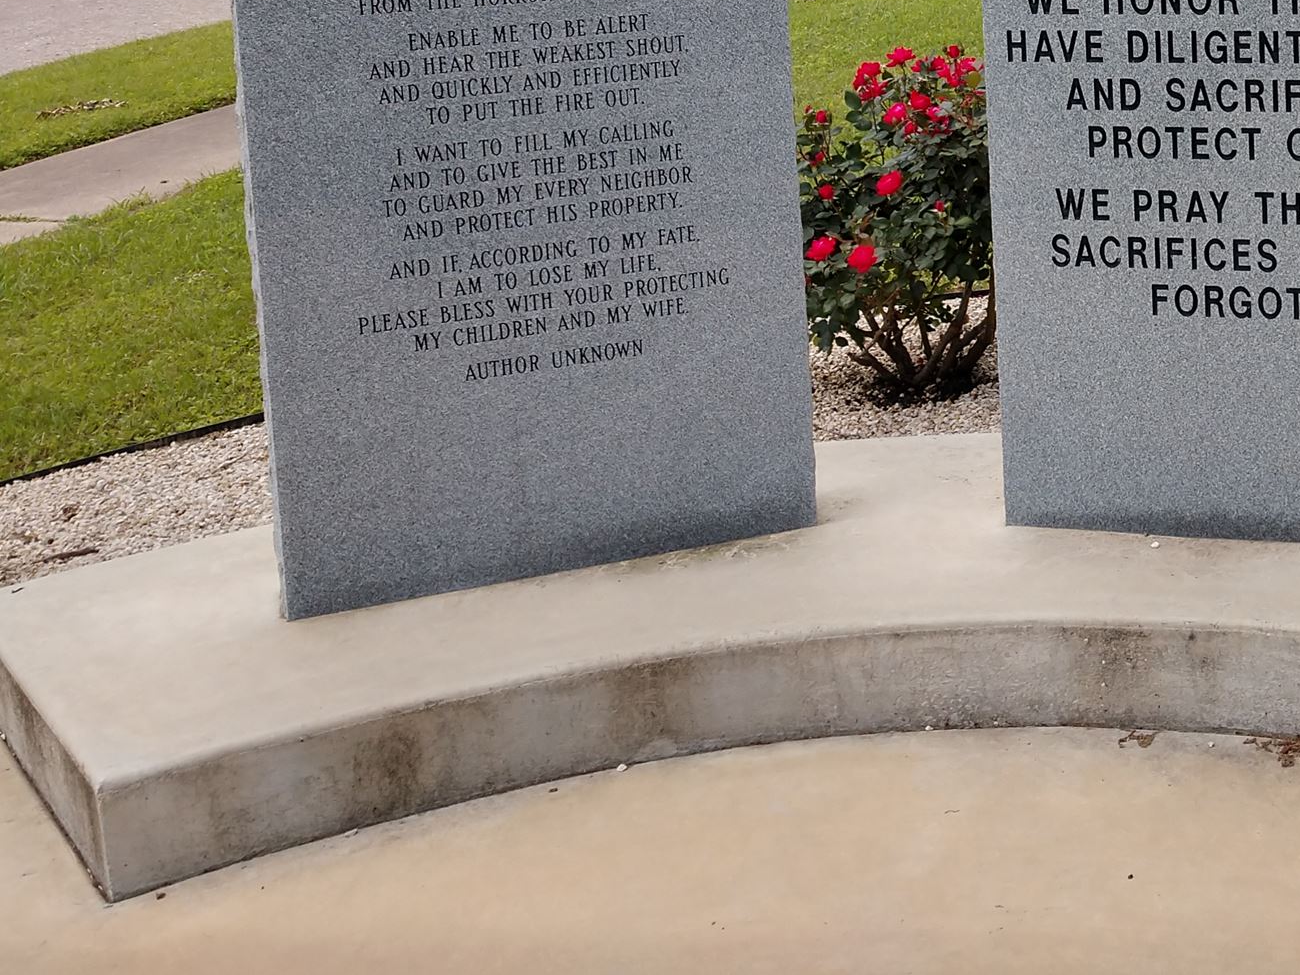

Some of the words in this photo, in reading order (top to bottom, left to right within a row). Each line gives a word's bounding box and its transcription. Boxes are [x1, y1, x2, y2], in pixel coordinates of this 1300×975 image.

[407, 27, 482, 52] ENABLE
[492, 24, 519, 45] ME
[526, 21, 553, 41] TO
[564, 18, 587, 38] BE
[595, 13, 649, 36] ALERT
[1005, 29, 1104, 64] HAVE
[369, 59, 411, 80] AND
[423, 53, 475, 76] HEAR
[486, 49, 524, 70] THE
[532, 40, 616, 64] WEAKEST
[379, 83, 420, 105] AND
[431, 74, 513, 100] QUICKLY
[522, 71, 562, 92] AND
[572, 59, 681, 87] EFFICIENTLY
[1066, 77, 1142, 112] AND
[423, 105, 450, 125] TO
[462, 101, 498, 122] PUT
[506, 96, 544, 117] THE
[555, 91, 596, 113] FIRE
[604, 87, 645, 108] OUT.
[396, 147, 402, 166] I
[414, 141, 468, 163] WANT
[476, 138, 502, 158] TO
[514, 133, 549, 154] FILL
[562, 128, 589, 149] MY
[599, 119, 674, 145] CALLING
[1087, 125, 1262, 161] PROTECT
[389, 170, 431, 193] AND
[438, 166, 466, 186] TO
[476, 160, 523, 183] GIVE
[528, 155, 566, 177] THE
[577, 149, 618, 172] BEST
[629, 146, 647, 166] IN
[659, 142, 685, 162] ME
[379, 198, 407, 218] TO
[418, 189, 485, 214] GUARD
[496, 184, 524, 204] MY
[534, 177, 590, 201] EVERY
[600, 165, 693, 193] NEIGHBOR
[1054, 187, 1111, 222] WE
[1132, 189, 1230, 224] PRAY
[403, 220, 444, 242] AND
[455, 207, 536, 235] PROTECT
[546, 203, 578, 224] HIS
[588, 191, 683, 219] PROPERTY.
[1051, 233, 1278, 274] SACRIFICES
[437, 281, 443, 299] I
[454, 276, 483, 297] AM
[491, 271, 518, 291] TO
[529, 264, 574, 287] LOSE
[584, 259, 610, 280] MY
[358, 308, 431, 336] PLEASE
[440, 299, 495, 324] BLESS
[505, 291, 553, 313] WITH
[563, 283, 614, 307] YOUR
[623, 267, 730, 299] PROTECTING
[413, 331, 442, 352] MY
[452, 316, 547, 347] CHILDREN
[557, 310, 596, 332] AND
[606, 304, 632, 324] MY
[465, 354, 540, 382] AUTHOR
[551, 339, 643, 369] UNKNOWN
